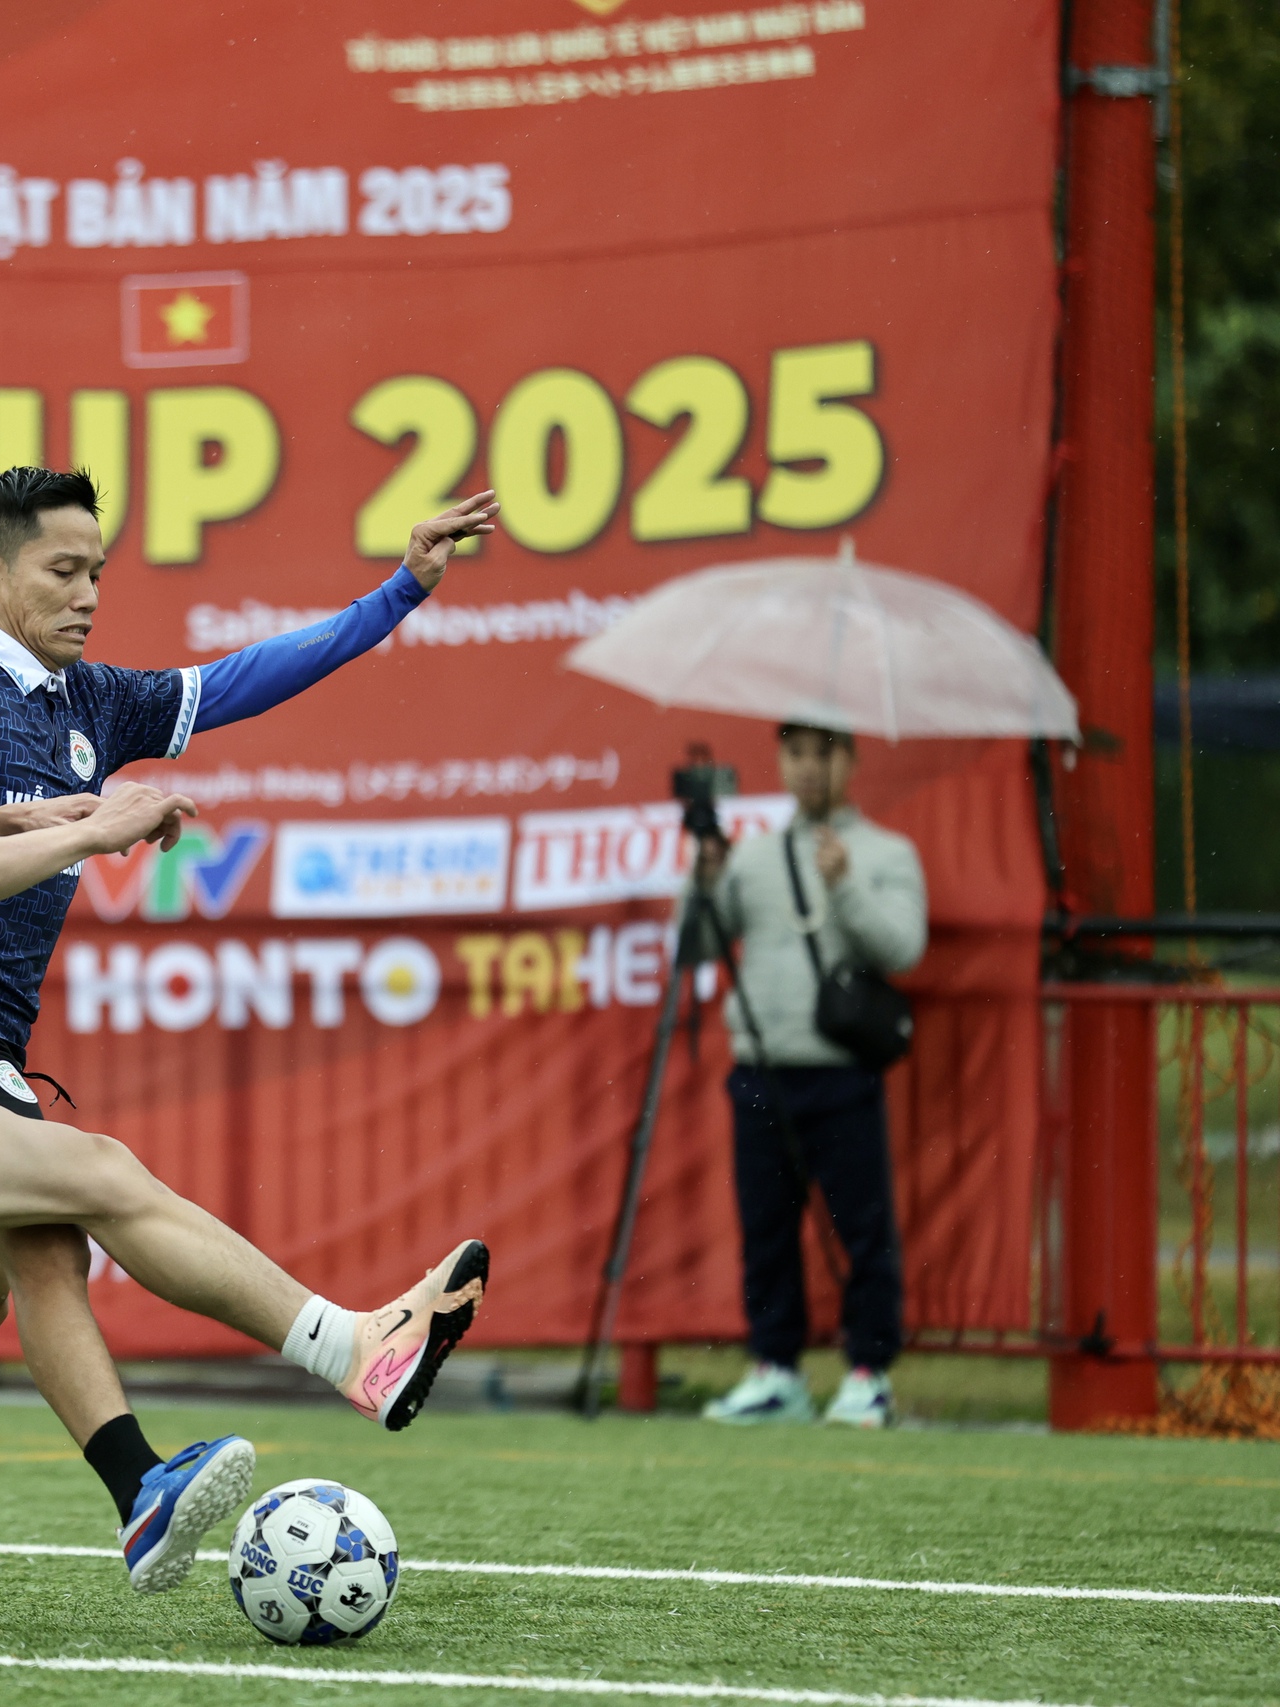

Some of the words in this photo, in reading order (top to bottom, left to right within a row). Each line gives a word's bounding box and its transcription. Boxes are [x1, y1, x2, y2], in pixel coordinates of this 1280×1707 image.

[65, 156, 197, 249] BẢN
[204, 159, 349, 244] NĂM
[356, 162, 513, 237] 2025
[349, 337, 886, 560] 2025
[82, 818, 273, 924] VTV
[64, 936, 441, 1034] HONTO
[287, 1569, 325, 1595] LUC
